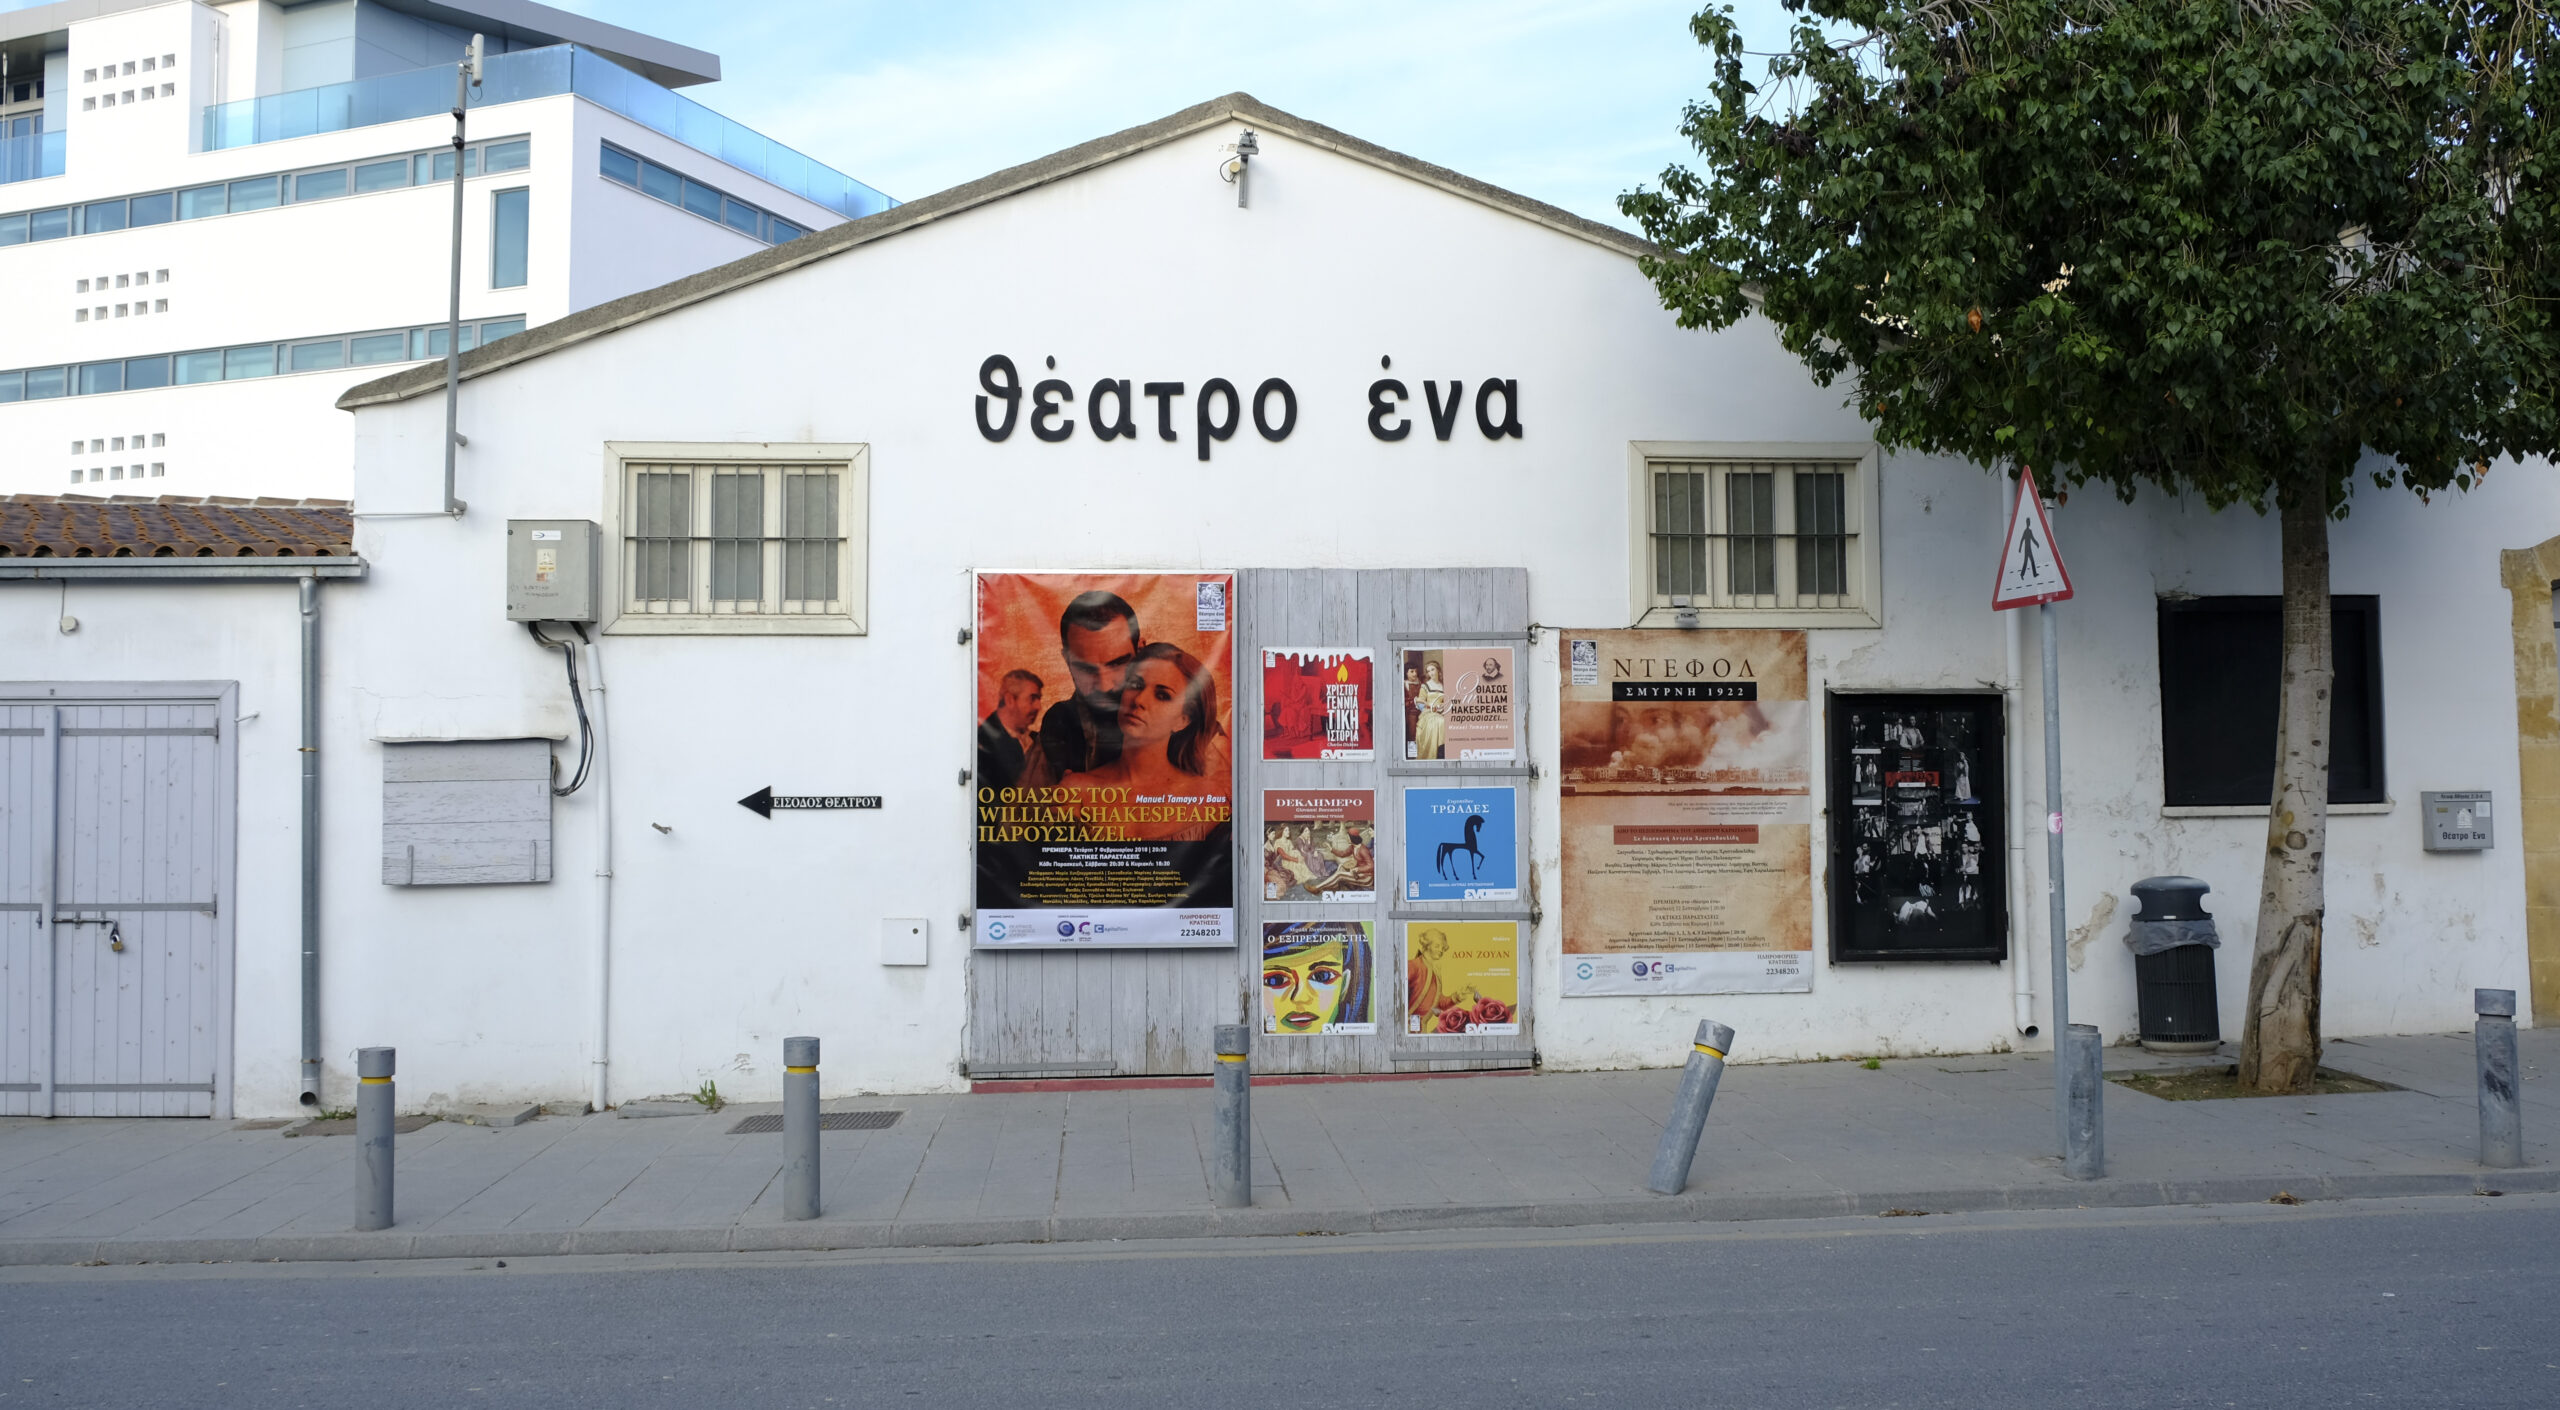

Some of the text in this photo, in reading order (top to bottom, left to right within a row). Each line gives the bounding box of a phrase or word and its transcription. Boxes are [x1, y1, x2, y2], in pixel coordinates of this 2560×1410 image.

[1613, 658, 1756, 678] ΝΤΕΦΟΛ
[1326, 684, 1359, 696] ΧΡΙΣΤΟΥ
[1626, 687, 1745, 697] ΣΜΥΡΝΗ 1922
[1326, 696, 1359, 710] ΓΕΝΝΙΑ
[1326, 710, 1359, 730] ΤΙΚΗ
[1328, 730, 1359, 742] ΙΣΤΟΡΙΑ
[1000, 787, 1082, 803] ΘΙΑΣΟΣ
[1087, 787, 1132, 803] ΤΟΥ
[1136, 794, 1226, 805] Manuel Tamayo y Baus
[773, 796, 878, 808] ΕΙΣΟΔΟΣ ΘΕΑΤΡΟΥ
[979, 806, 1231, 823] WILLIAM SHAKESPEARE
[1431, 804, 1490, 814] ΤΡΩΑΔΕΣ
[978, 826, 1142, 842] ΠΑΡΟΥΣΙΑΖΕΙ...
[1180, 929, 1221, 937] 22348203
[1279, 934, 1369, 943] ΕΞΠΡΕΣΙΟΝΙΣΤΗΣ
[1452, 951, 1510, 959] ΔΟΝ ΖΟΥΑΝ
